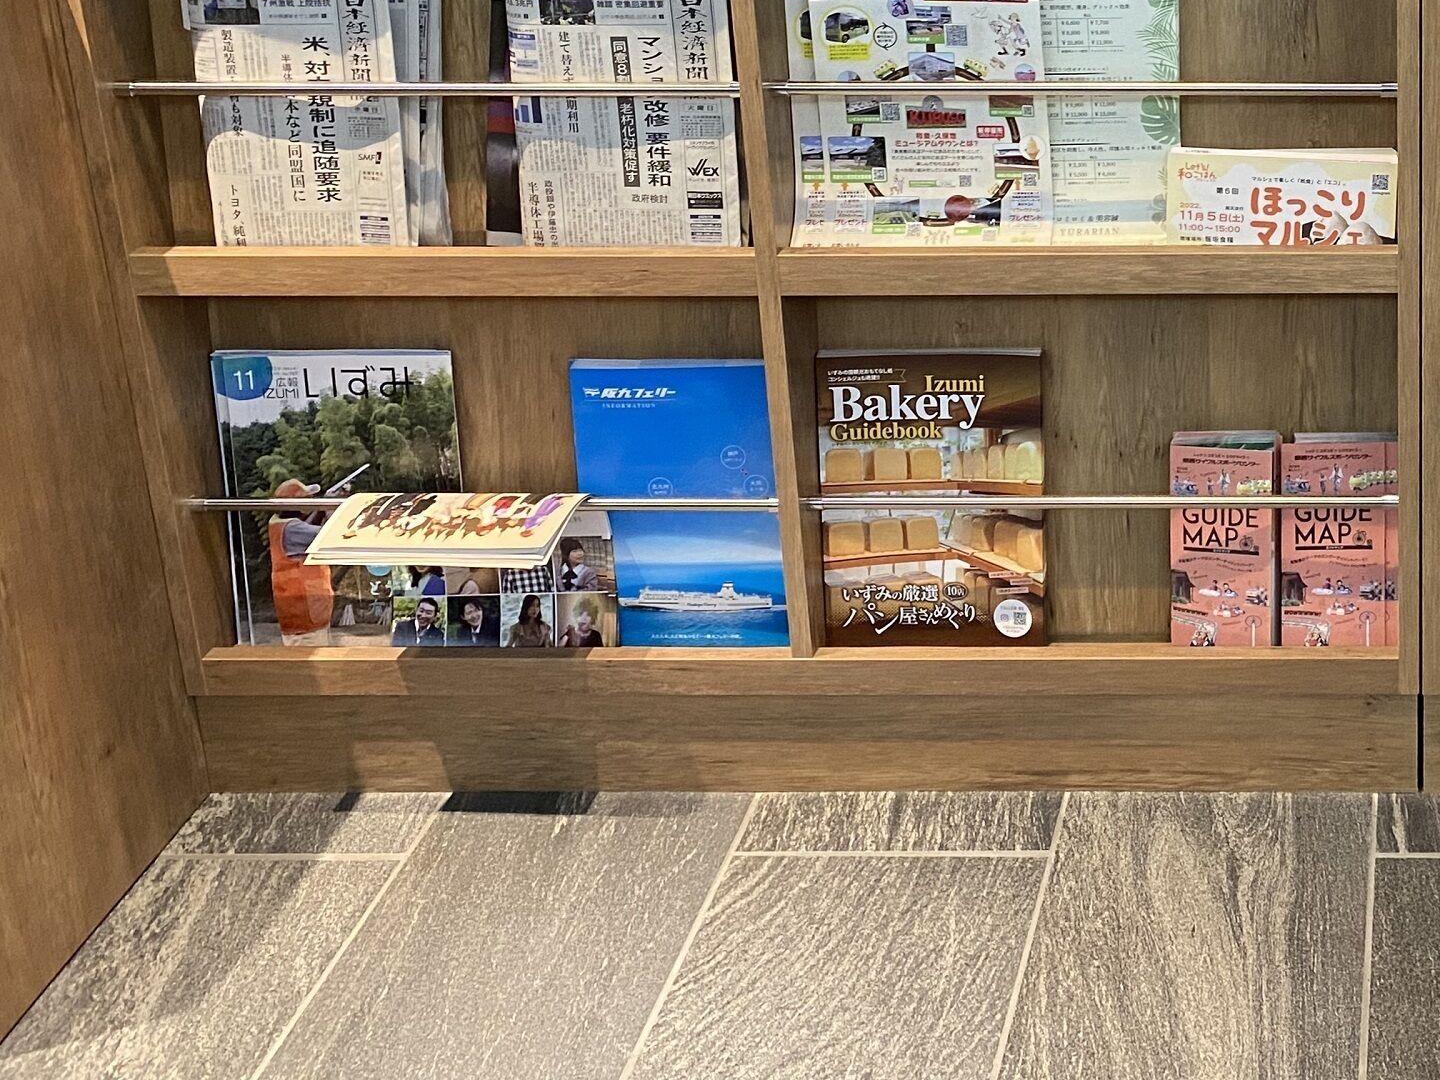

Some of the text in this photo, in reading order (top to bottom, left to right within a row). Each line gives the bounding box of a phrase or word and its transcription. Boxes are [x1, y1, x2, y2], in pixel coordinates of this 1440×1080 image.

[1250, 186, 1366, 221] ほっこり
[1250, 220, 1363, 246] マルシェ
[233, 369, 255, 391] 11
[302, 364, 415, 399] いずみ
[924, 374, 985, 393] Izumi
[600, 387, 677, 399] 阪九フェリー
[828, 384, 986, 430] Bakery
[829, 421, 943, 441] Guidebook
[1182, 508, 1259, 528] GUIDE
[1182, 523, 1239, 548] MAP
[1294, 522, 1352, 545] MAP
[842, 583, 939, 602] いずみの厳選
[842, 602, 976, 635] パン屋さんめぐり
